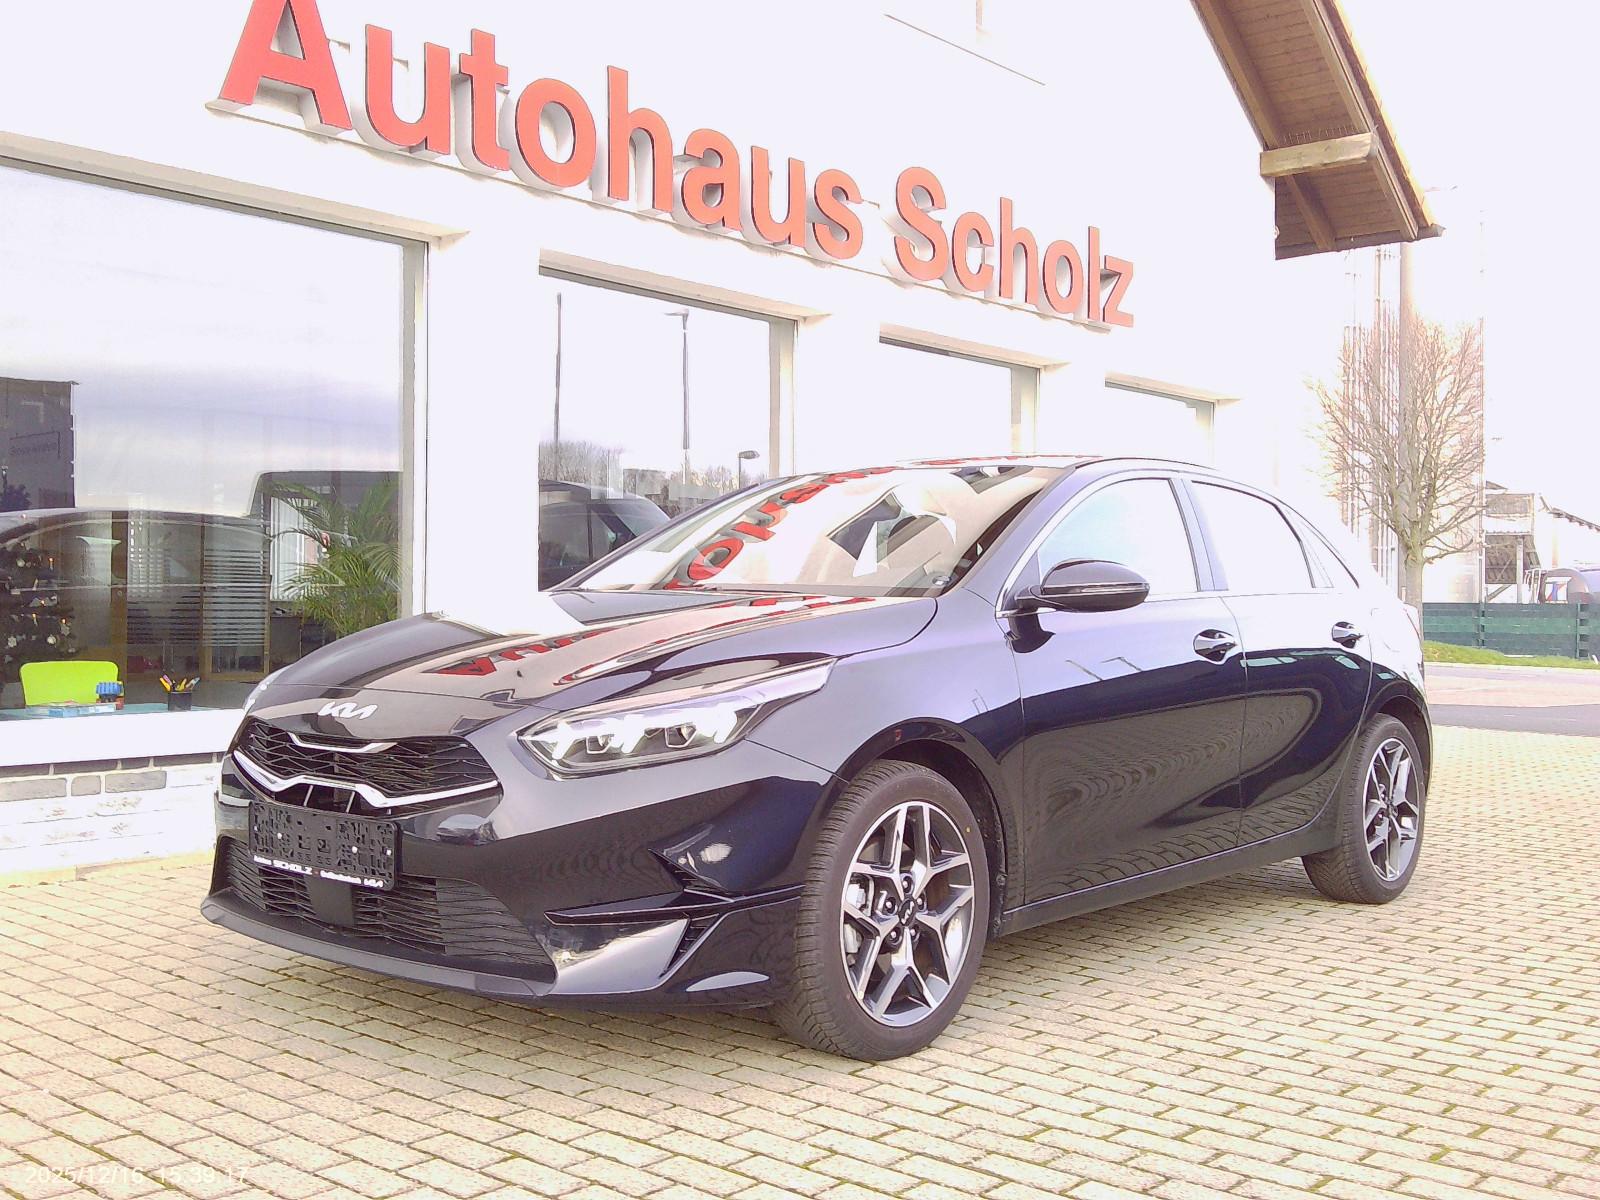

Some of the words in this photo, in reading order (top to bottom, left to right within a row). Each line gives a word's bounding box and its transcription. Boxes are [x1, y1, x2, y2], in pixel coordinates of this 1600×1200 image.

[221, 0, 862, 258] Autohaus
[895, 167, 1133, 327] Scholz
[318, 701, 378, 720] KIA
